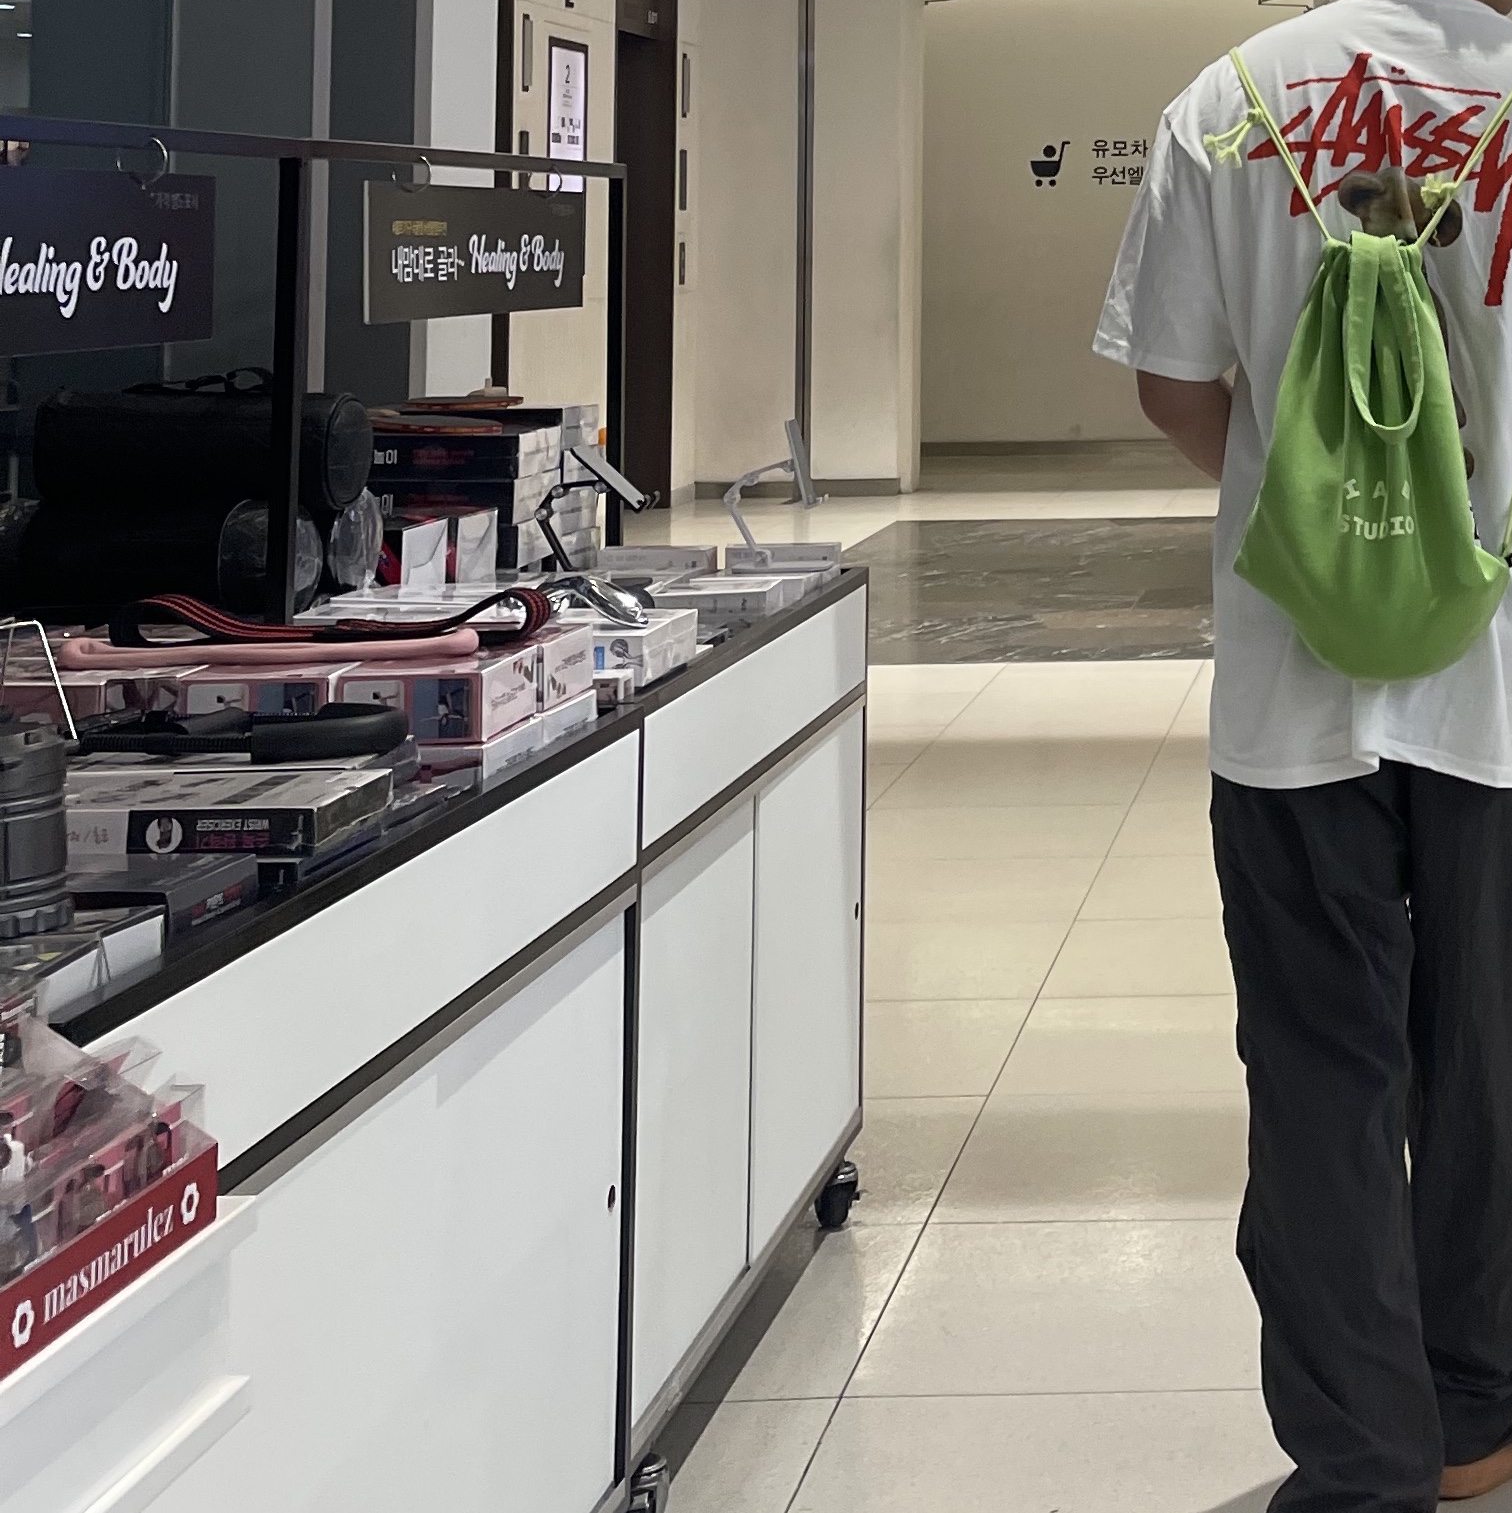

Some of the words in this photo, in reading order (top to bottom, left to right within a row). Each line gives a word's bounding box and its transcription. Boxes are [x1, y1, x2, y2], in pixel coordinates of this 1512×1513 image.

[1092, 139, 1149, 159] 유모차
[86, 236, 110, 291] &
[112, 237, 178, 313] Body
[391, 244, 435, 283] 내맘대로
[469, 234, 518, 290] Healing
[519, 234, 531, 272] &
[531, 234, 565, 288] Body
[1340, 514, 1415, 541] STUDIO
[43, 1204, 175, 1325] masmarulez
